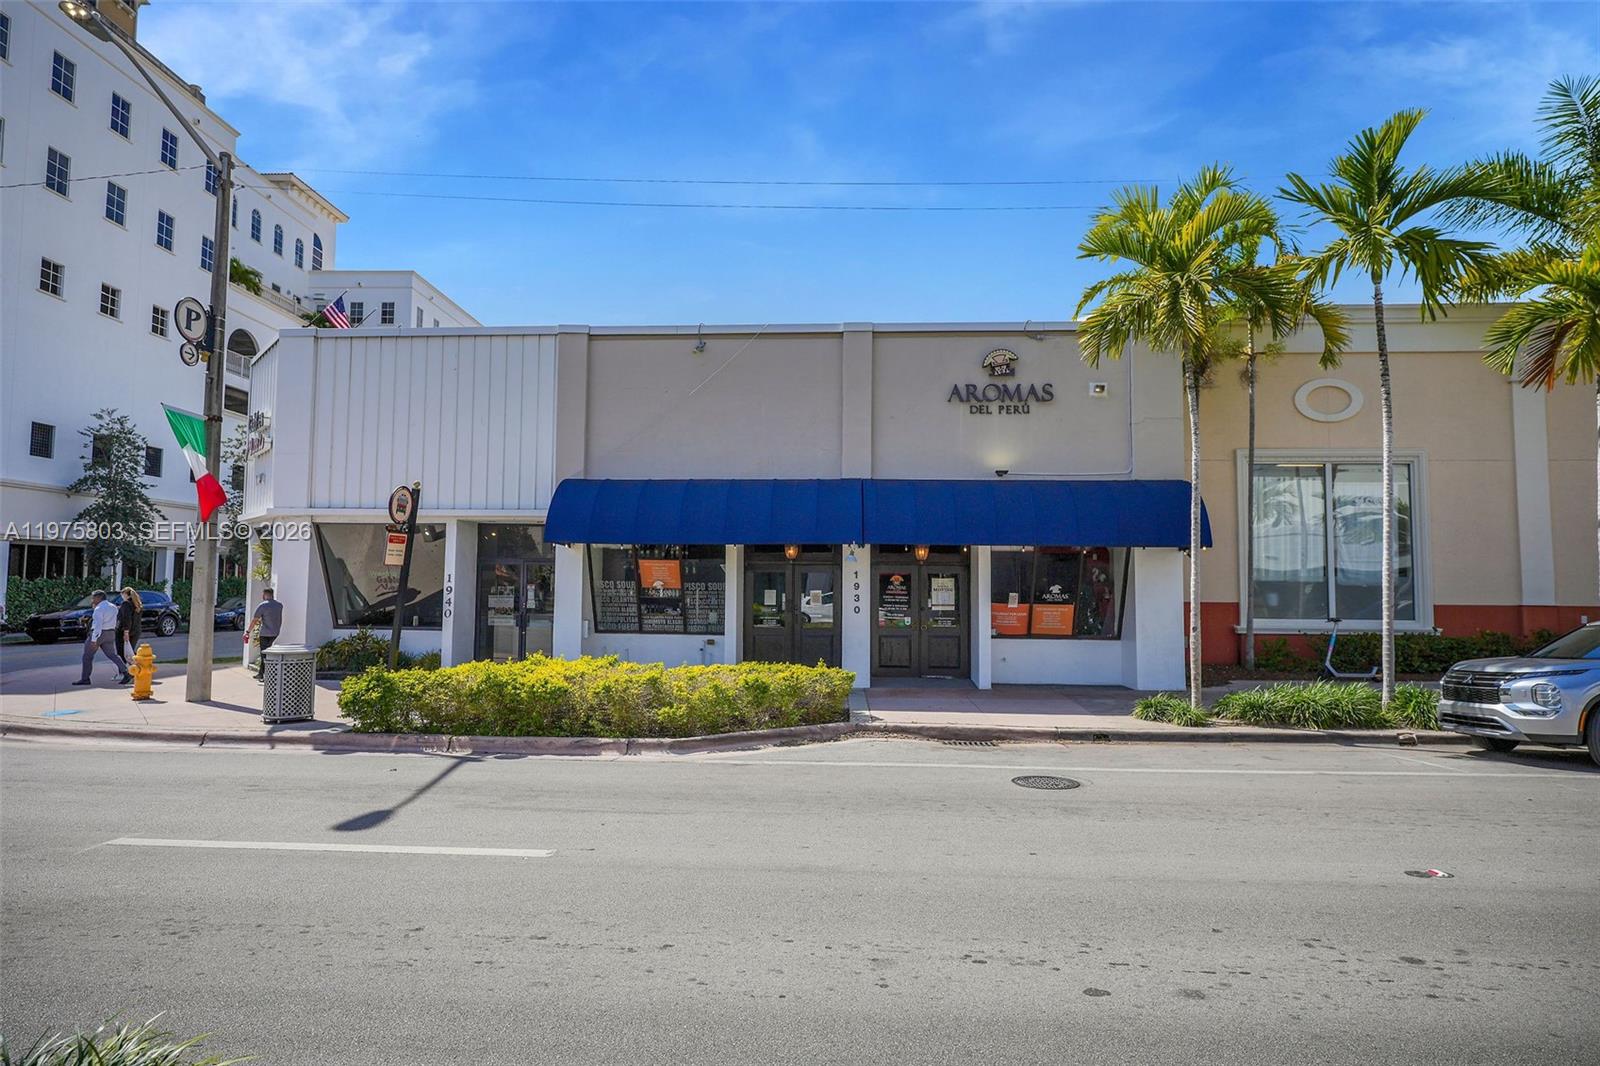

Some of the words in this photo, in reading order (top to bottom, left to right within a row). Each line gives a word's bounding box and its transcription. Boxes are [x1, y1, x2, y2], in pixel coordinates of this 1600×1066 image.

[185, 306, 202, 332] P
[947, 383, 1054, 402] AROMAS
[969, 405, 992, 415] DEL
[998, 402, 1030, 415] PERÚ
[444, 573, 453, 619] 1940
[683, 582, 706, 591] PISCO
[853, 570, 861, 614] 1930
